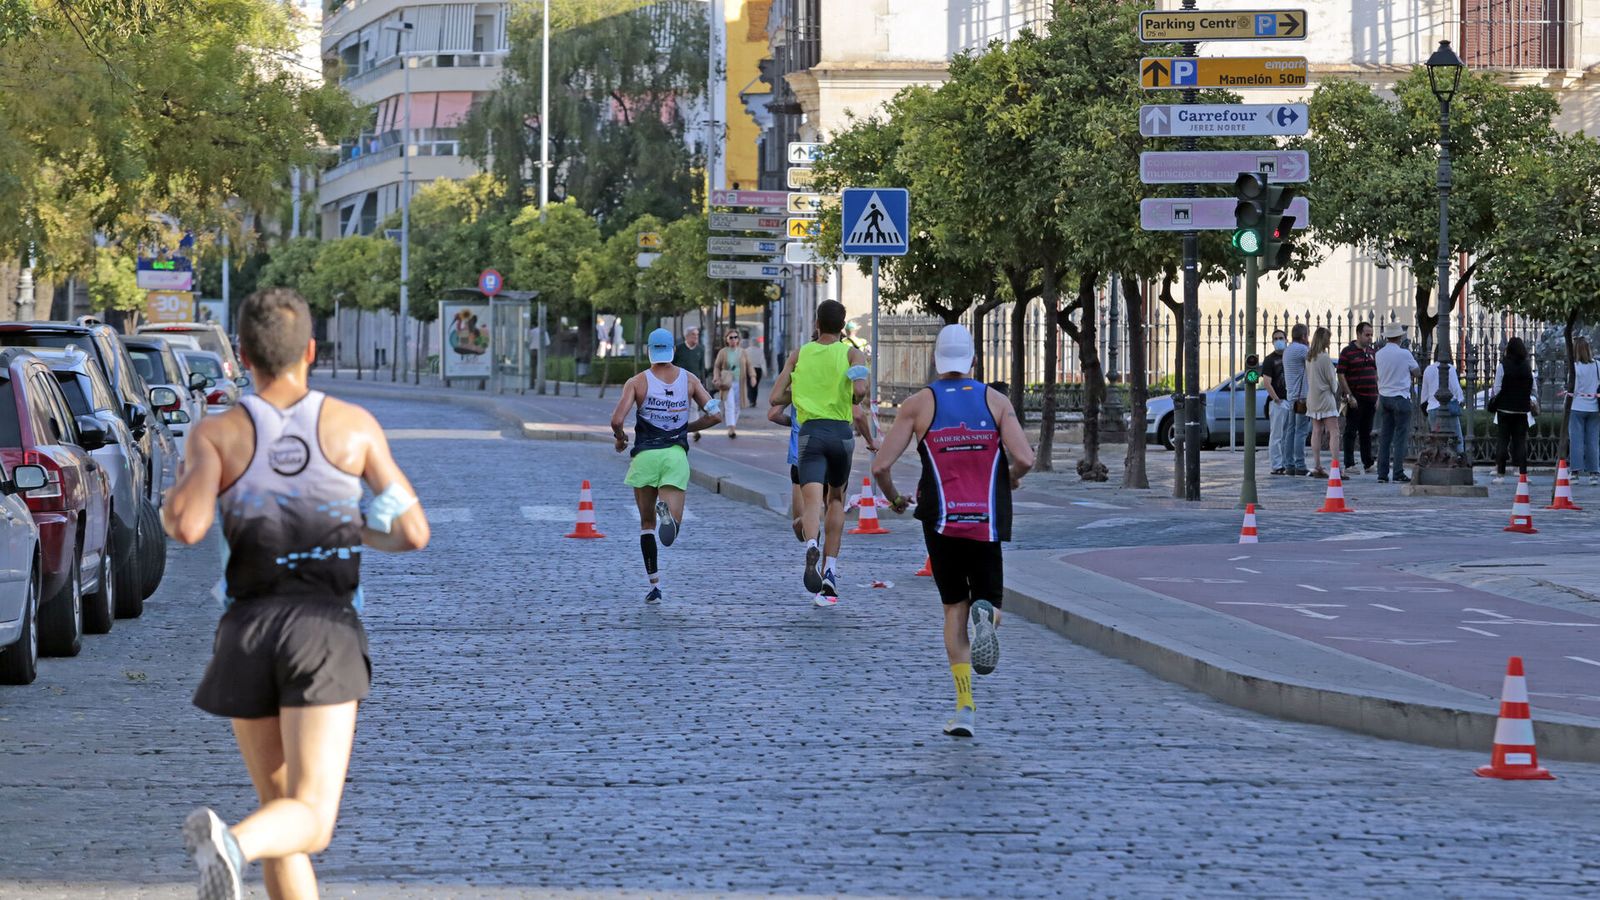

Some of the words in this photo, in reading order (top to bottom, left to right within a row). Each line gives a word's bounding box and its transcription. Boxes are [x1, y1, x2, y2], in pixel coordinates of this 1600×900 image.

[1145, 19, 1196, 31] Parking
[1258, 15, 1273, 34] P
[1264, 60, 1306, 71] empark
[1174, 61, 1194, 85] P
[1219, 73, 1273, 85] Mamelón
[1279, 73, 1306, 84] 50m
[1178, 109, 1258, 122] Carrefour
[1189, 124, 1215, 132] JEREZ
[1217, 124, 1246, 132] NORTE
[1146, 169, 1197, 179] municipal
[1200, 170, 1214, 178] de
[971, 433, 993, 441] SPORT
